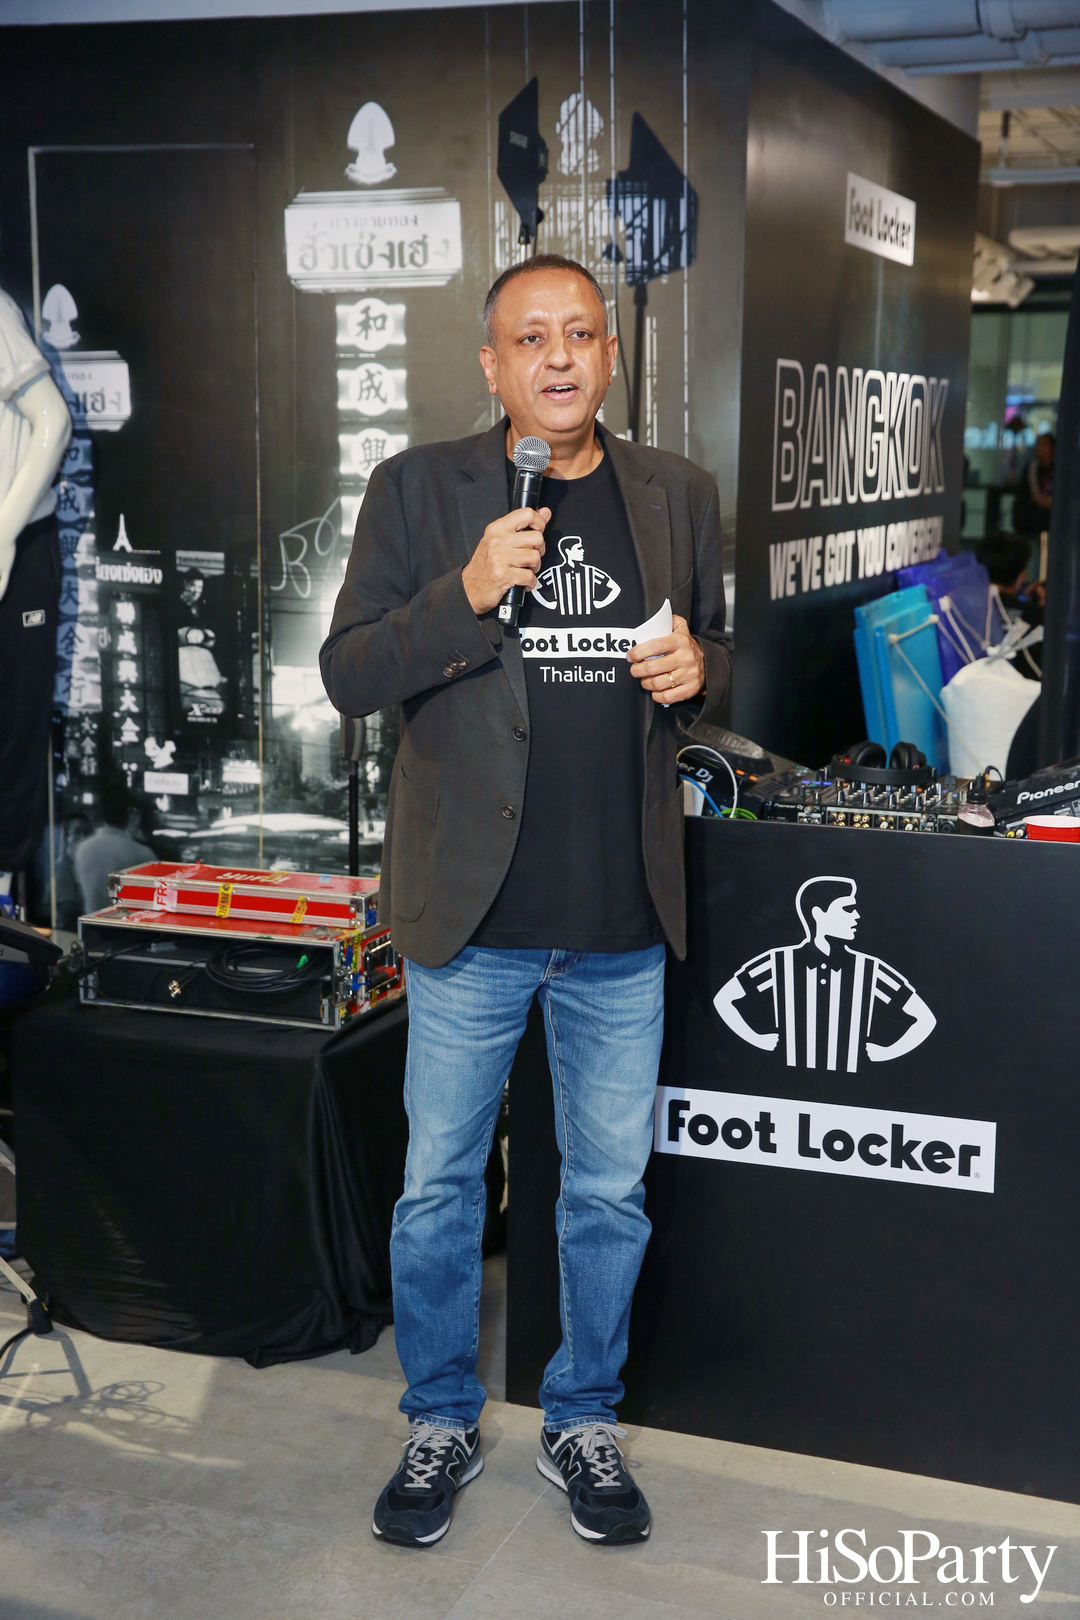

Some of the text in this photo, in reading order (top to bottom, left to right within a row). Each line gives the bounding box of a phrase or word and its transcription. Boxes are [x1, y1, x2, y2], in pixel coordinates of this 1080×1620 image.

[848, 187, 911, 251] Foot Locker
[772, 358, 949, 512] BANGKOK
[769, 536, 823, 601] WE'VE
[823, 530, 856, 588] GOT
[857, 524, 886, 580] YOU
[519, 634, 560, 652] oot
[539, 666, 616, 683] Thailand
[668, 1098, 982, 1178] Foot Locker
